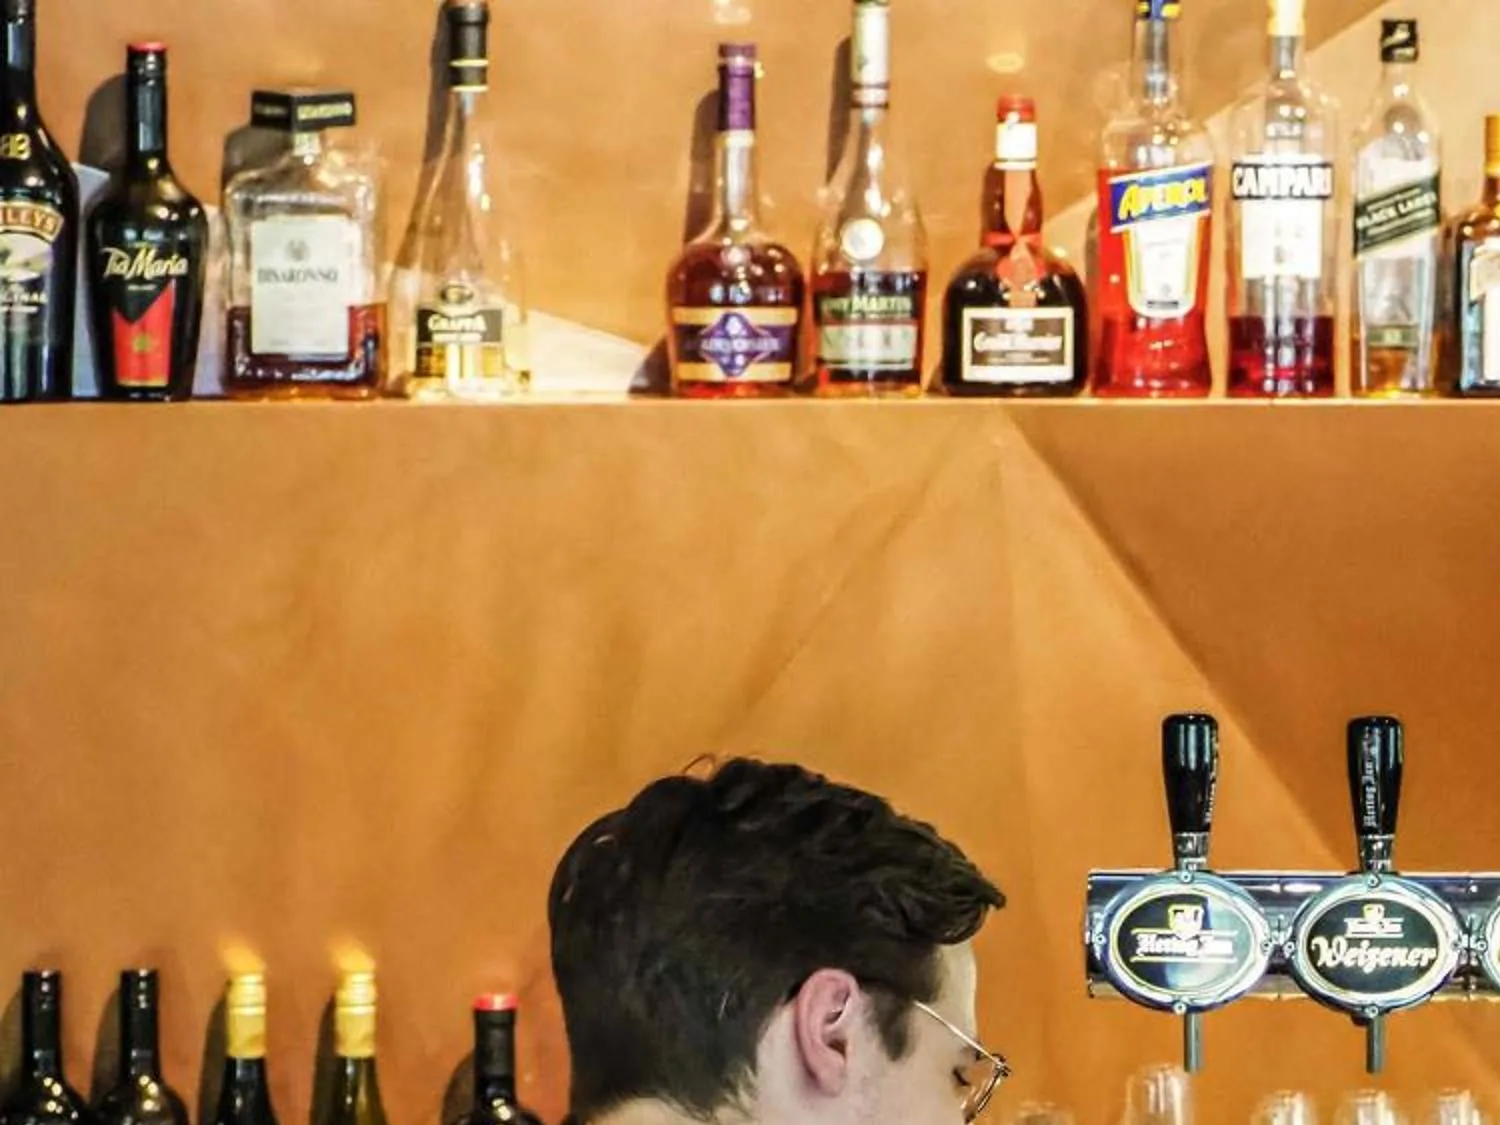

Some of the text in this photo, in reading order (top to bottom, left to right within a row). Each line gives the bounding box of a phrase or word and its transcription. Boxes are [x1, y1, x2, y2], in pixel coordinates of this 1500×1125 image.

[1118, 177, 1208, 220] APEROL
[1233, 165, 1331, 197] CAMPARI
[1356, 206, 1397, 230] BLACK
[1398, 191, 1437, 214] LABEL
[101, 247, 189, 279] Tia Maria
